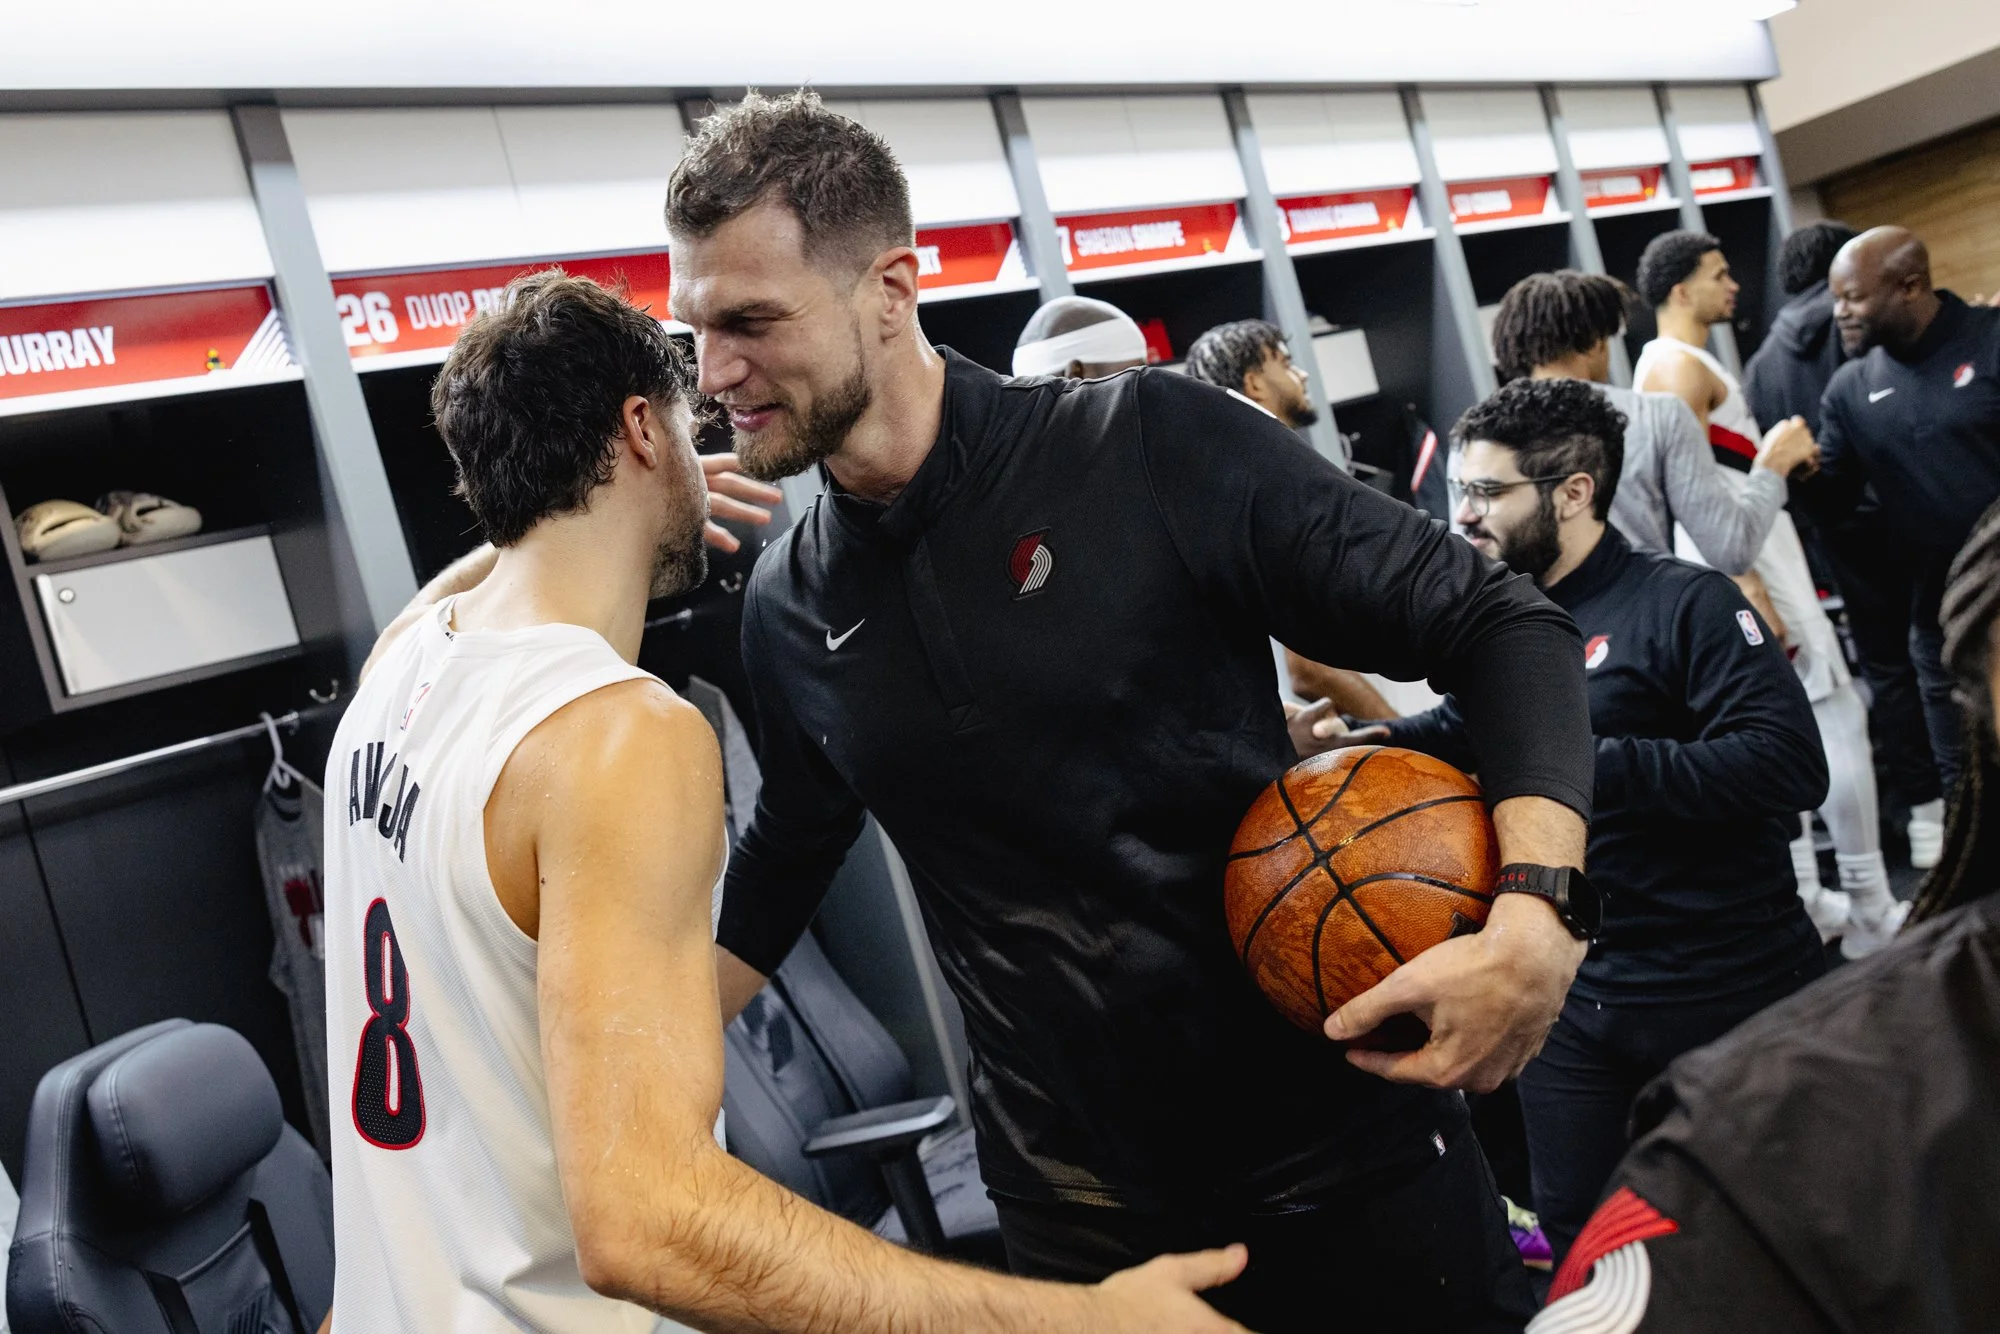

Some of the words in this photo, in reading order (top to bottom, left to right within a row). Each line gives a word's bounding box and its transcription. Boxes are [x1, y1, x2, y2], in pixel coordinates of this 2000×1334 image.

[335, 291, 399, 347] 26
[404, 291, 472, 331] DUOP
[351, 897, 427, 1150] 8
